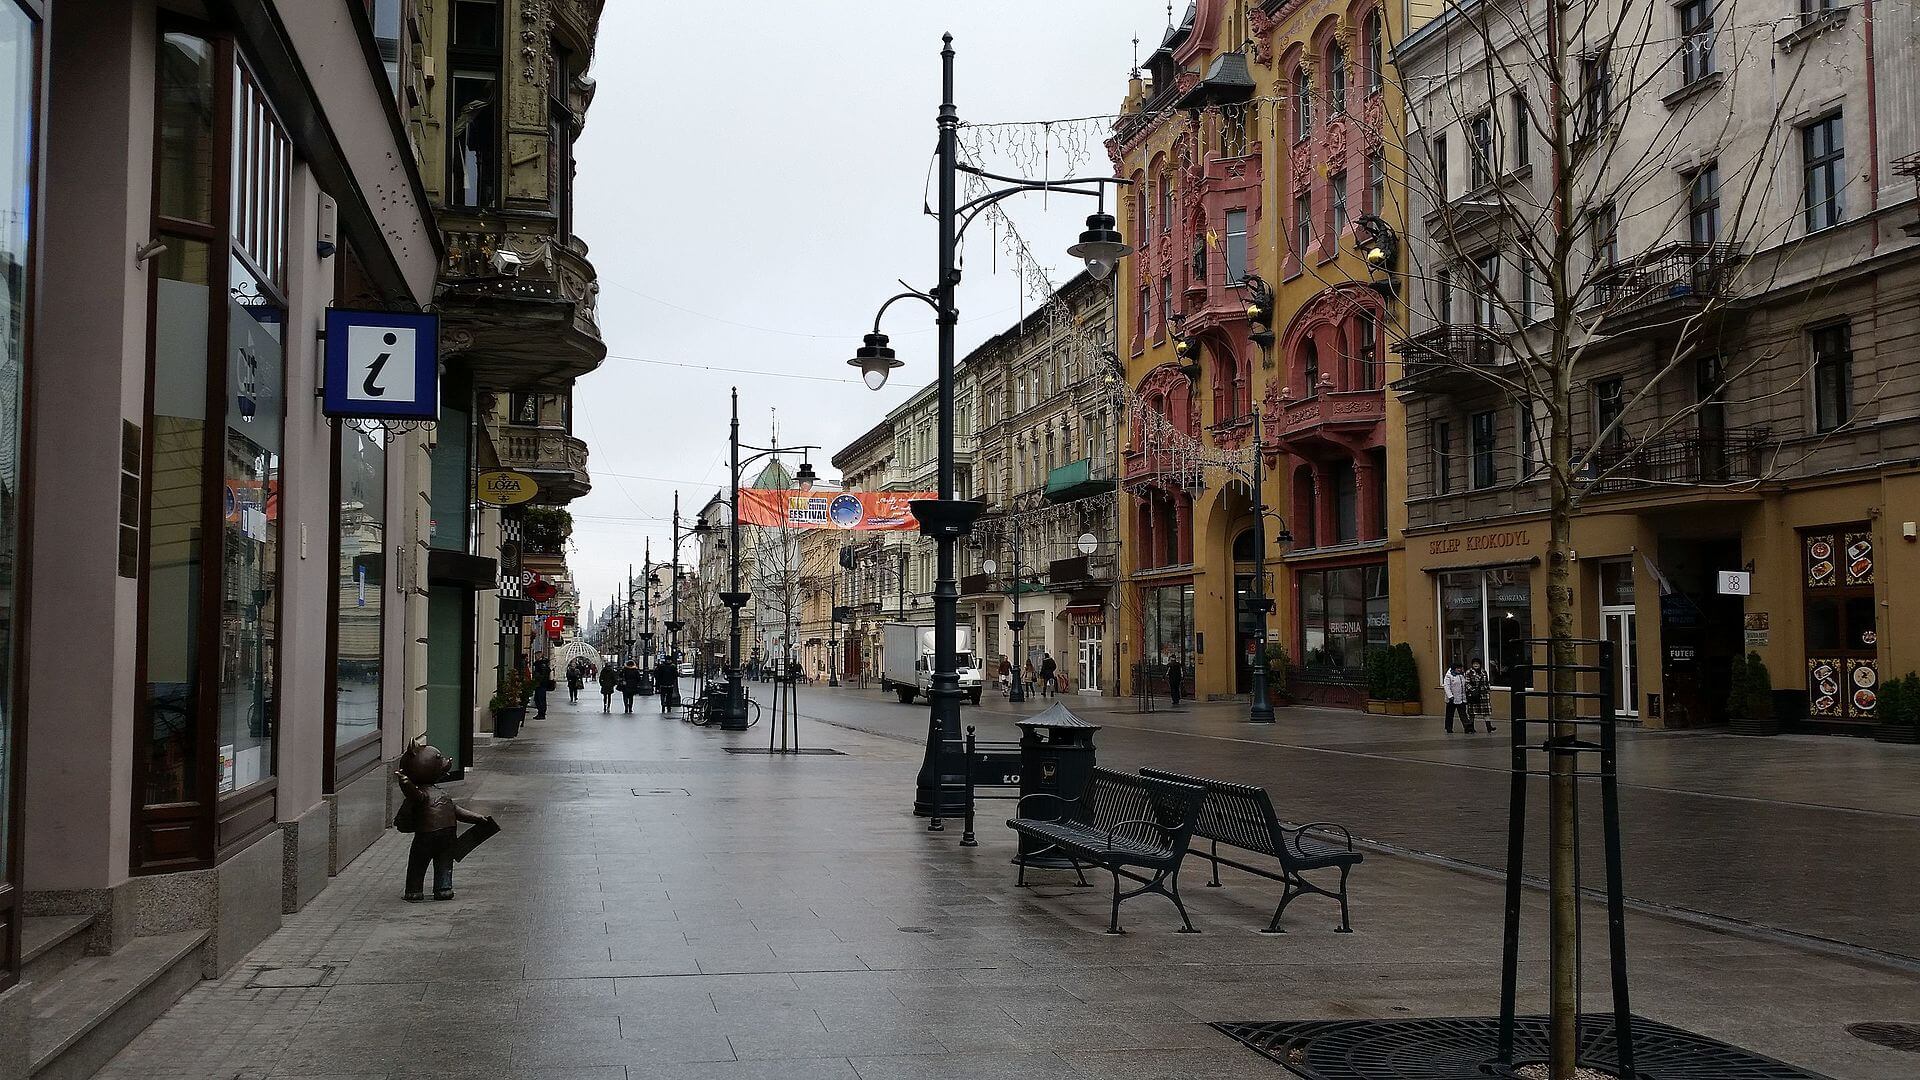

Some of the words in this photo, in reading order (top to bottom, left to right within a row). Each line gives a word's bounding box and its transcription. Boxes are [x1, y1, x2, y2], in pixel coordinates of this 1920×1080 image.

[789, 510, 827, 519] FESTIVAL
[1429, 538, 1461, 555] SKLEP
[1466, 530, 1530, 551] KROKODYL
[1670, 650, 1695, 658] FUTER
